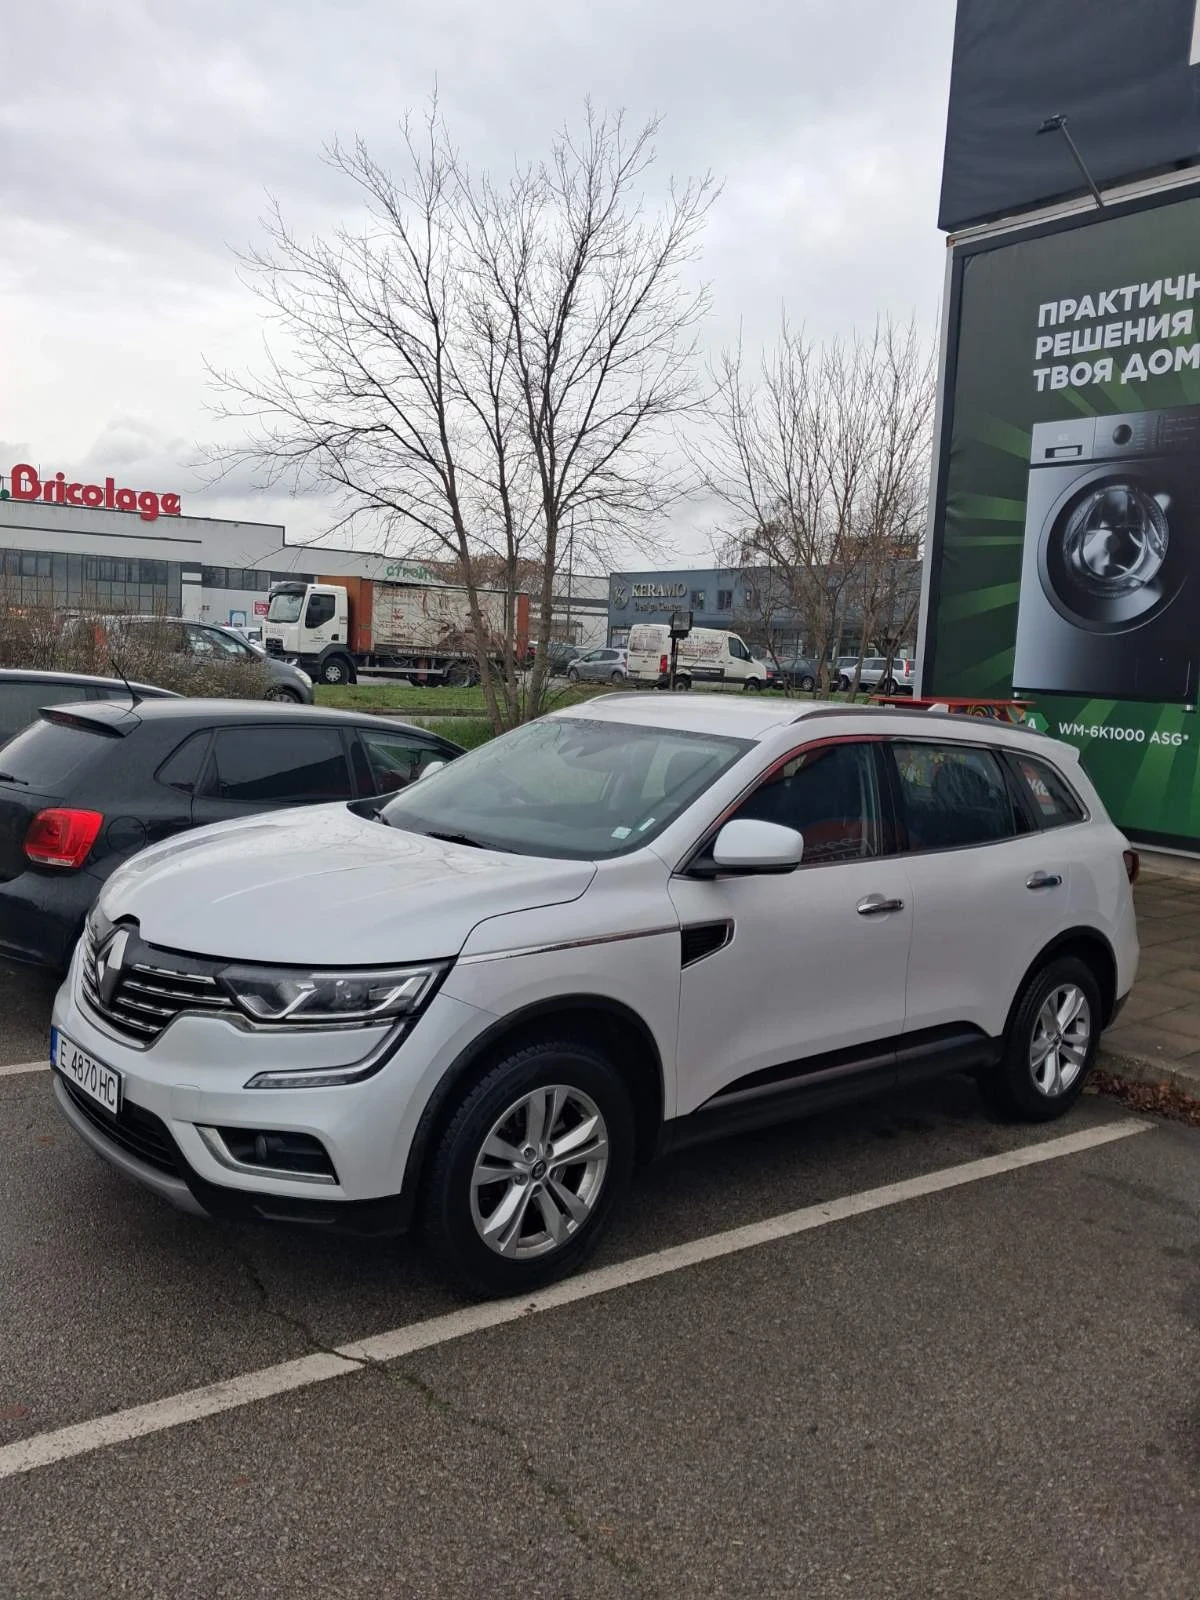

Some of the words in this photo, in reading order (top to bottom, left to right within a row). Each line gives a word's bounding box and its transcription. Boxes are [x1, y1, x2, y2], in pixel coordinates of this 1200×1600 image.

[1035, 309, 1193, 359] РЕШЕНИЯ
[1033, 358, 1113, 391] ТВОЯ
[1121, 344, 1200, 384] ДОМ
[11, 464, 181, 521] Bricolage
[632, 583, 687, 597] KERAMO
[1059, 722, 1145, 742] WM-6K1000
[60, 1040, 67, 1069] E
[71, 1050, 97, 1092] 4870
[98, 1069, 116, 1107] HC
